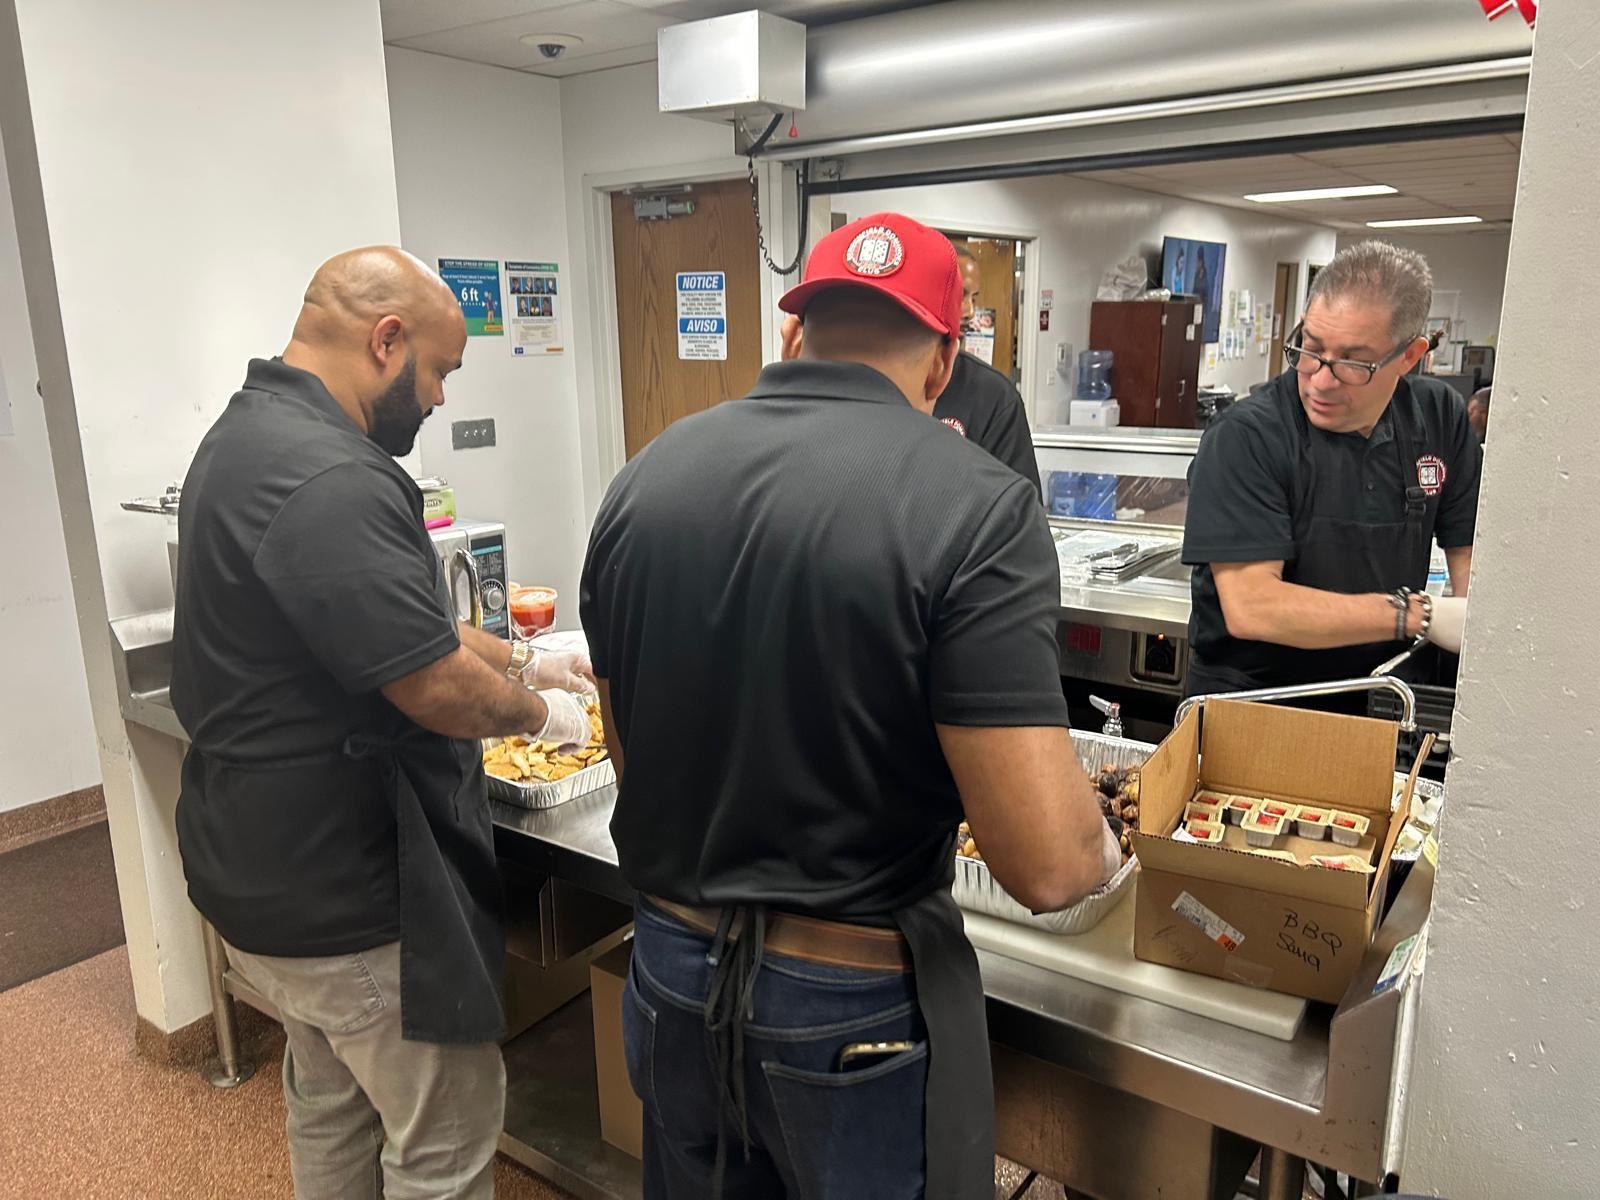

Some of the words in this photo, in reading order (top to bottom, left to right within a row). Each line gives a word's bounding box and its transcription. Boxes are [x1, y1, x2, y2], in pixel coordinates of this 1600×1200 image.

[682, 276, 719, 289] NOTICE
[461, 287, 468, 302] 6
[470, 287, 479, 302] ft
[686, 319, 717, 332] AVISO
[1283, 907, 1343, 957] BBQ
